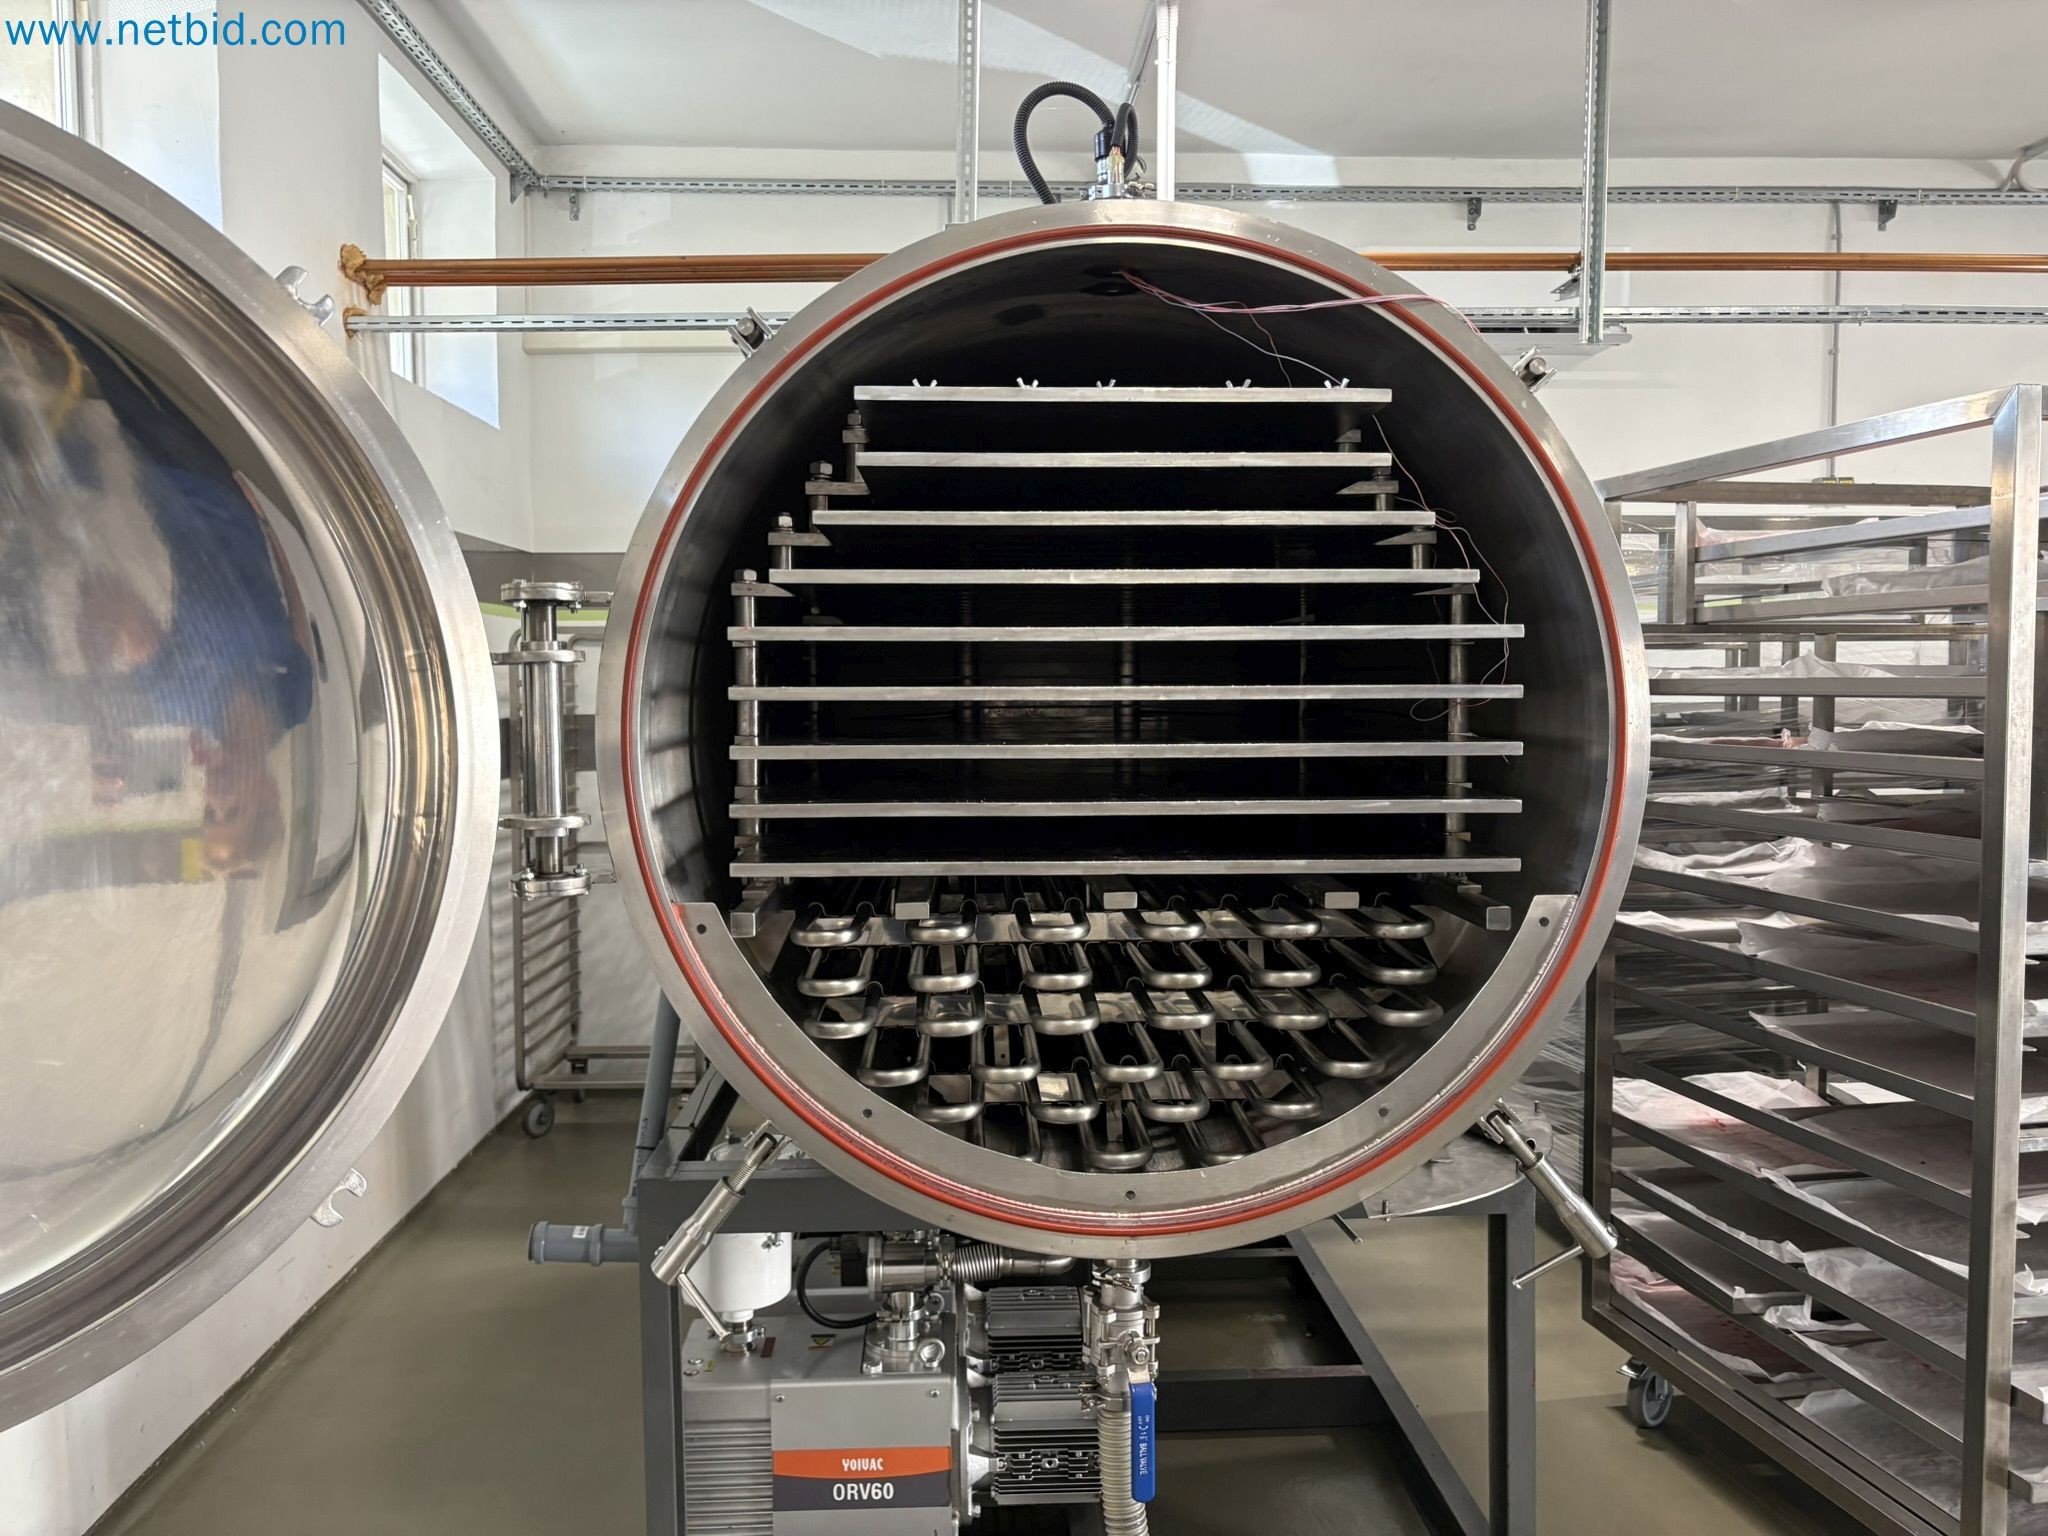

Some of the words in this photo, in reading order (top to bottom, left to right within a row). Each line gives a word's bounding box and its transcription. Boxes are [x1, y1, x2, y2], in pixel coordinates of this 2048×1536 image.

[1139, 1442, 1148, 1457] BALL
[1139, 1457, 1148, 1475] VALVE
[832, 1482, 895, 1501] ORV60
